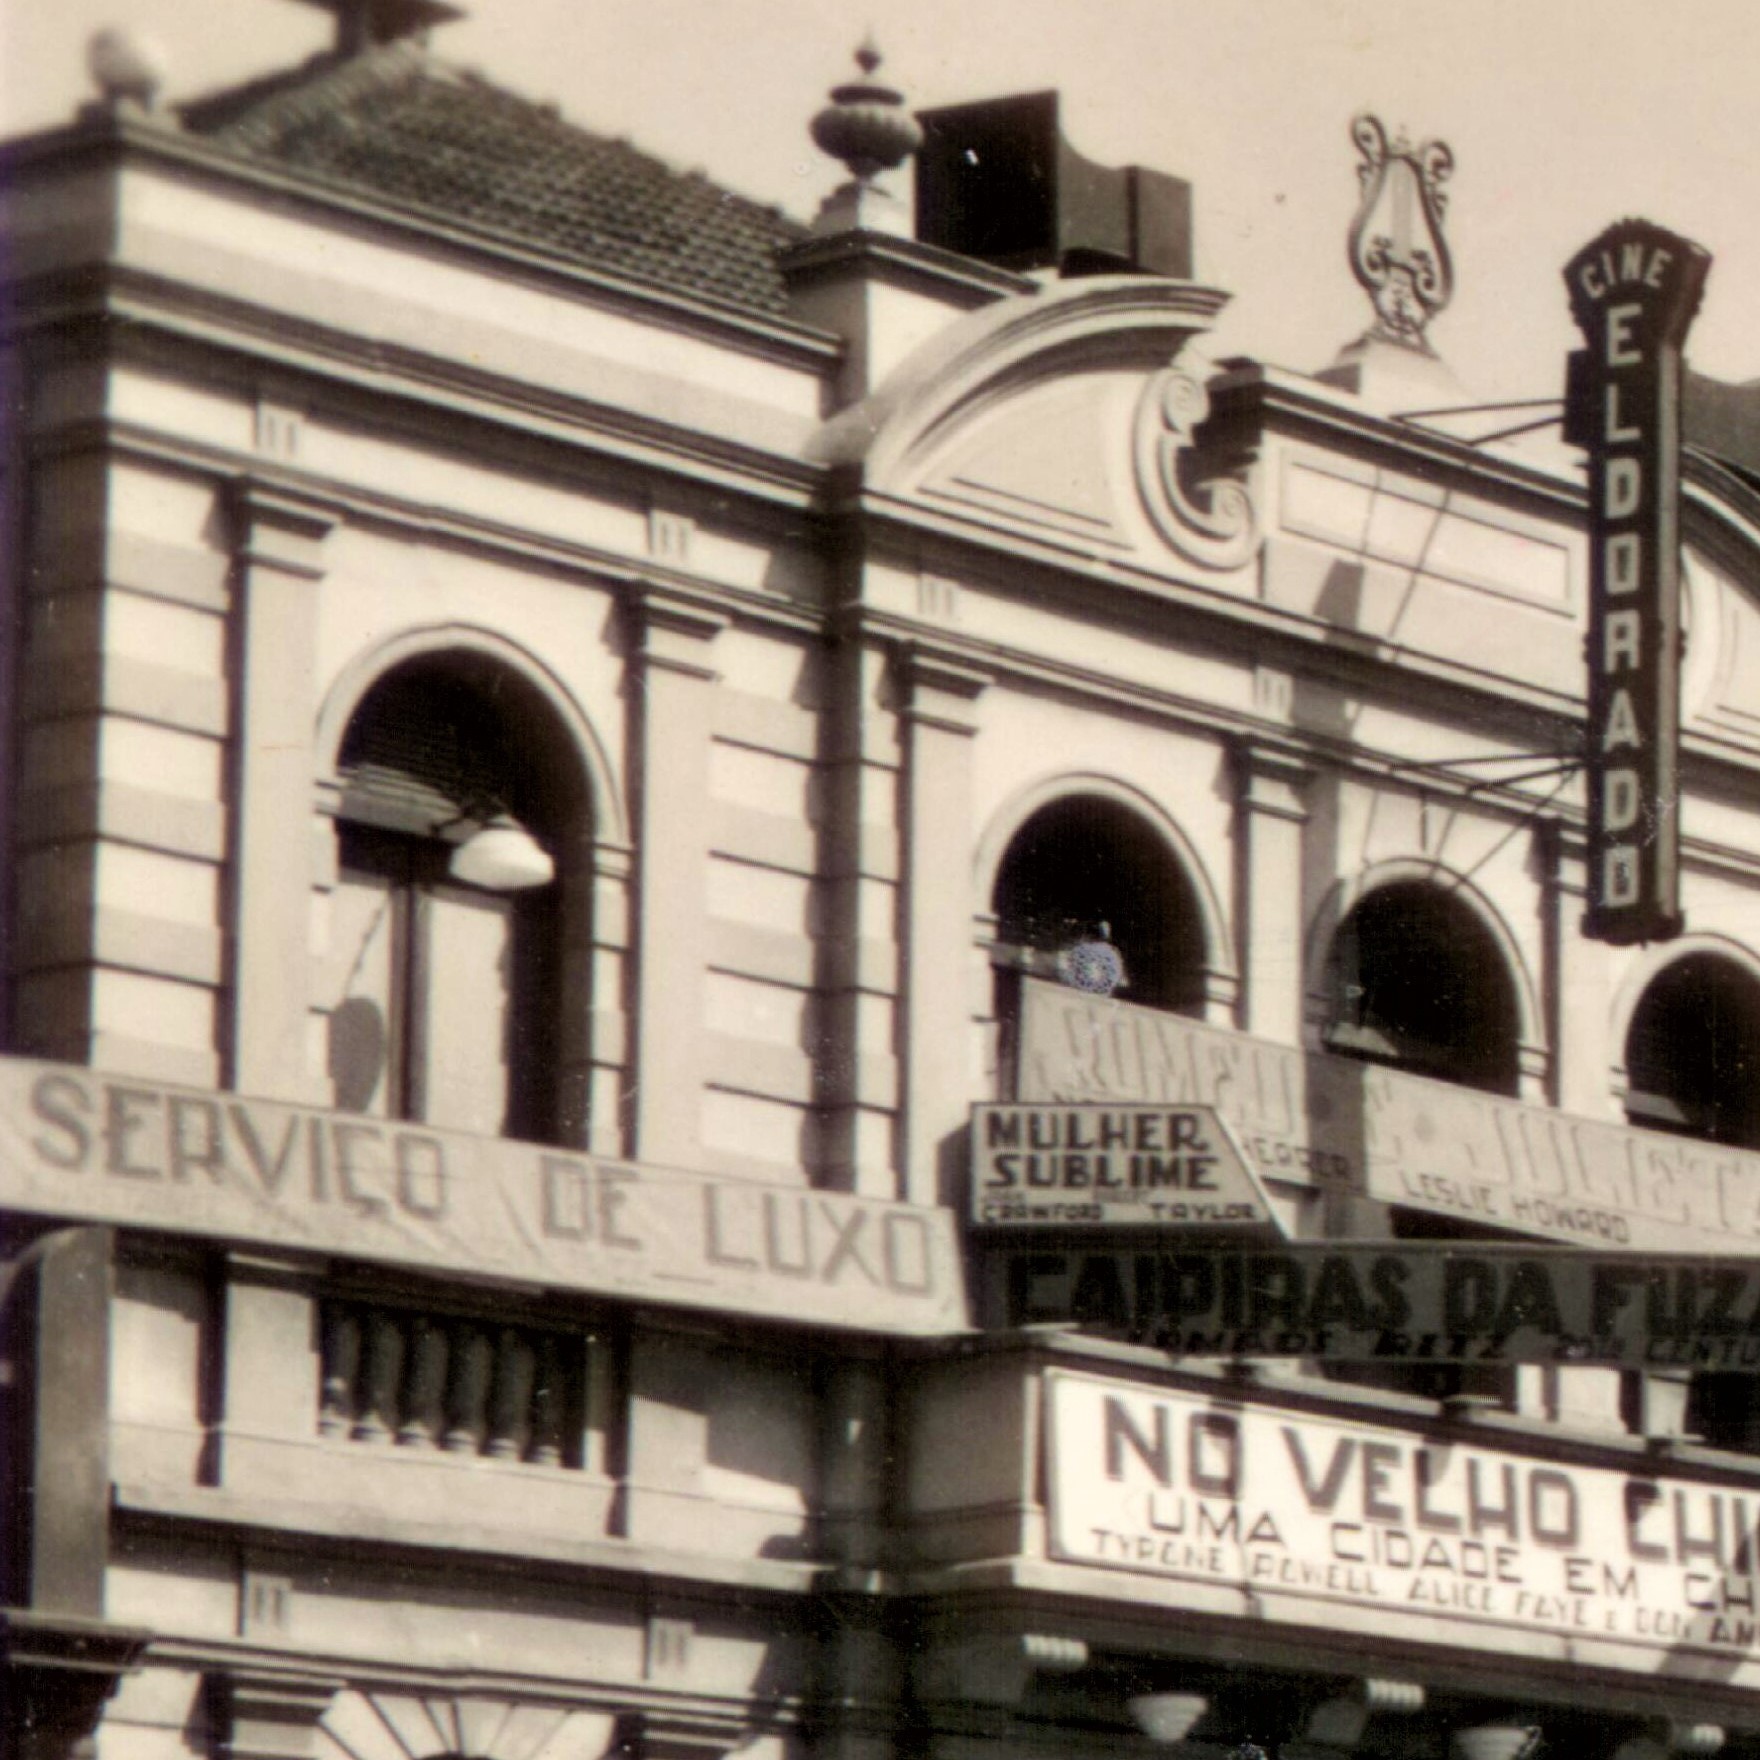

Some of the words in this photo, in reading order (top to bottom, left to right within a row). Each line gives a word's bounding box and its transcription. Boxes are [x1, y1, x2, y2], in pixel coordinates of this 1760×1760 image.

[1578, 245, 1674, 299] CINE
[1604, 303, 1642, 908] ELDORADO
[984, 1153, 1219, 1191] SUBLIME
[987, 1111, 1210, 1150] MULHER
[28, 1073, 449, 1223] SERVIÇO
[539, 1154, 644, 1250] DE
[703, 1184, 937, 1298] LUXO
[981, 1202, 1104, 1222] CRAWFORD
[1150, 1201, 1256, 1220] TAYLOR
[1399, 1169, 1498, 1216] LESLIE
[1510, 1195, 1632, 1246] HOWARD
[1006, 1254, 1411, 1332] CAIPIRAS
[1443, 1256, 1563, 1338] DA
[1102, 1394, 1241, 1497] NO
[1281, 1426, 1578, 1549] VELHO
[1090, 1528, 1226, 1574] TYRONE
[1407, 1576, 1494, 1612] ALICE
[1515, 1591, 1588, 1627] FAYE
[1634, 1606, 1691, 1641] DON
[1149, 1493, 1284, 1546] UMA
[1329, 1521, 1524, 1585] CIDADE
[1563, 1557, 1640, 1598] EM
